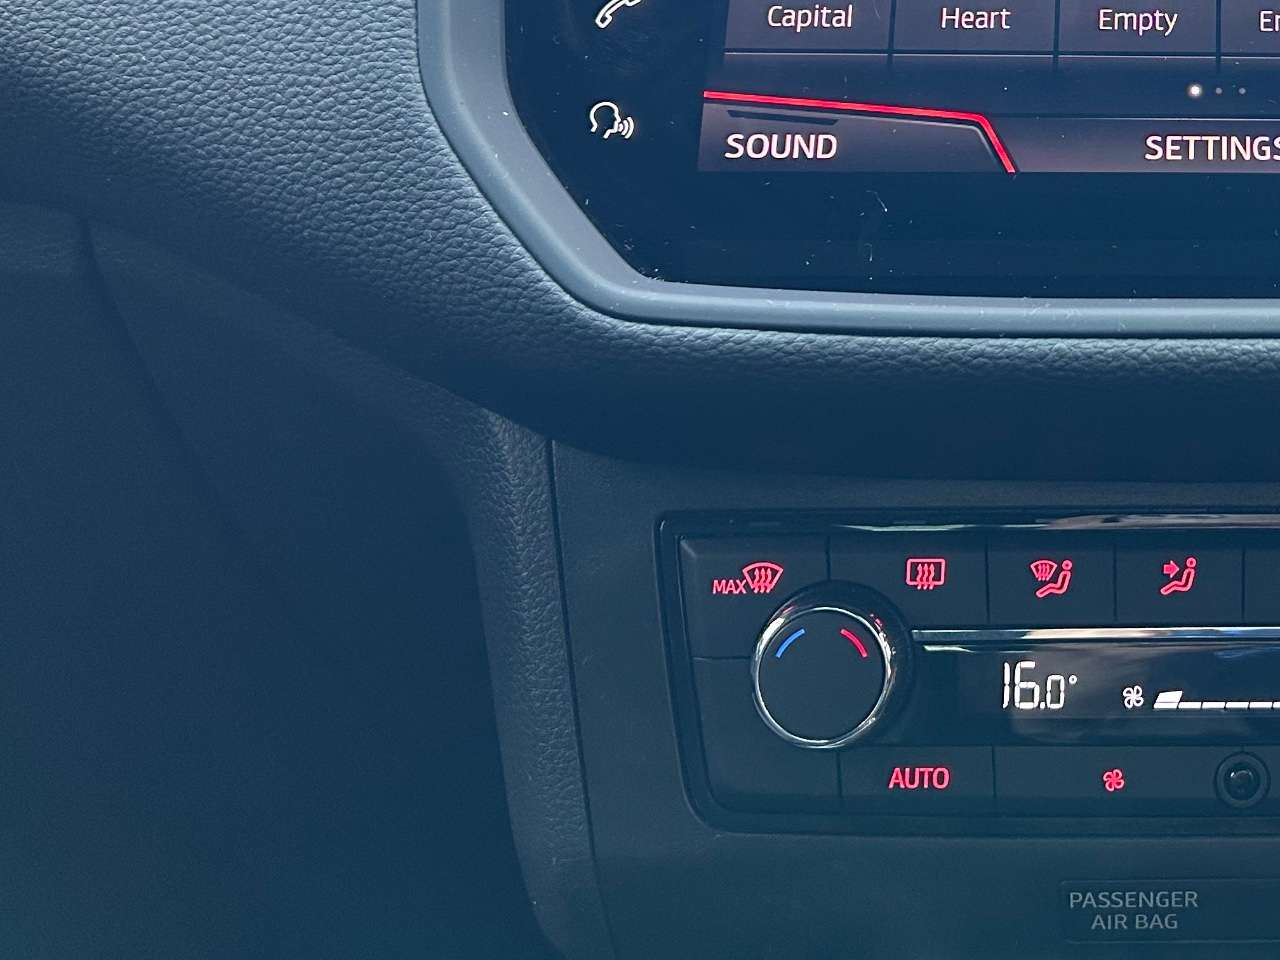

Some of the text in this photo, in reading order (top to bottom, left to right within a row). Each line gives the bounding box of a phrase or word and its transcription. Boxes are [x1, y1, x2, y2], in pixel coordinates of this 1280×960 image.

[767, 4, 853, 33] Capital
[941, 7, 1012, 29] Heart
[1099, 8, 1178, 37] Empty
[724, 133, 838, 159] SOUND
[712, 580, 747, 595] MAX
[888, 767, 950, 789] AUTO
[1069, 890, 1198, 909] PASSENGER
[1091, 913, 1178, 930] AIR BAG
